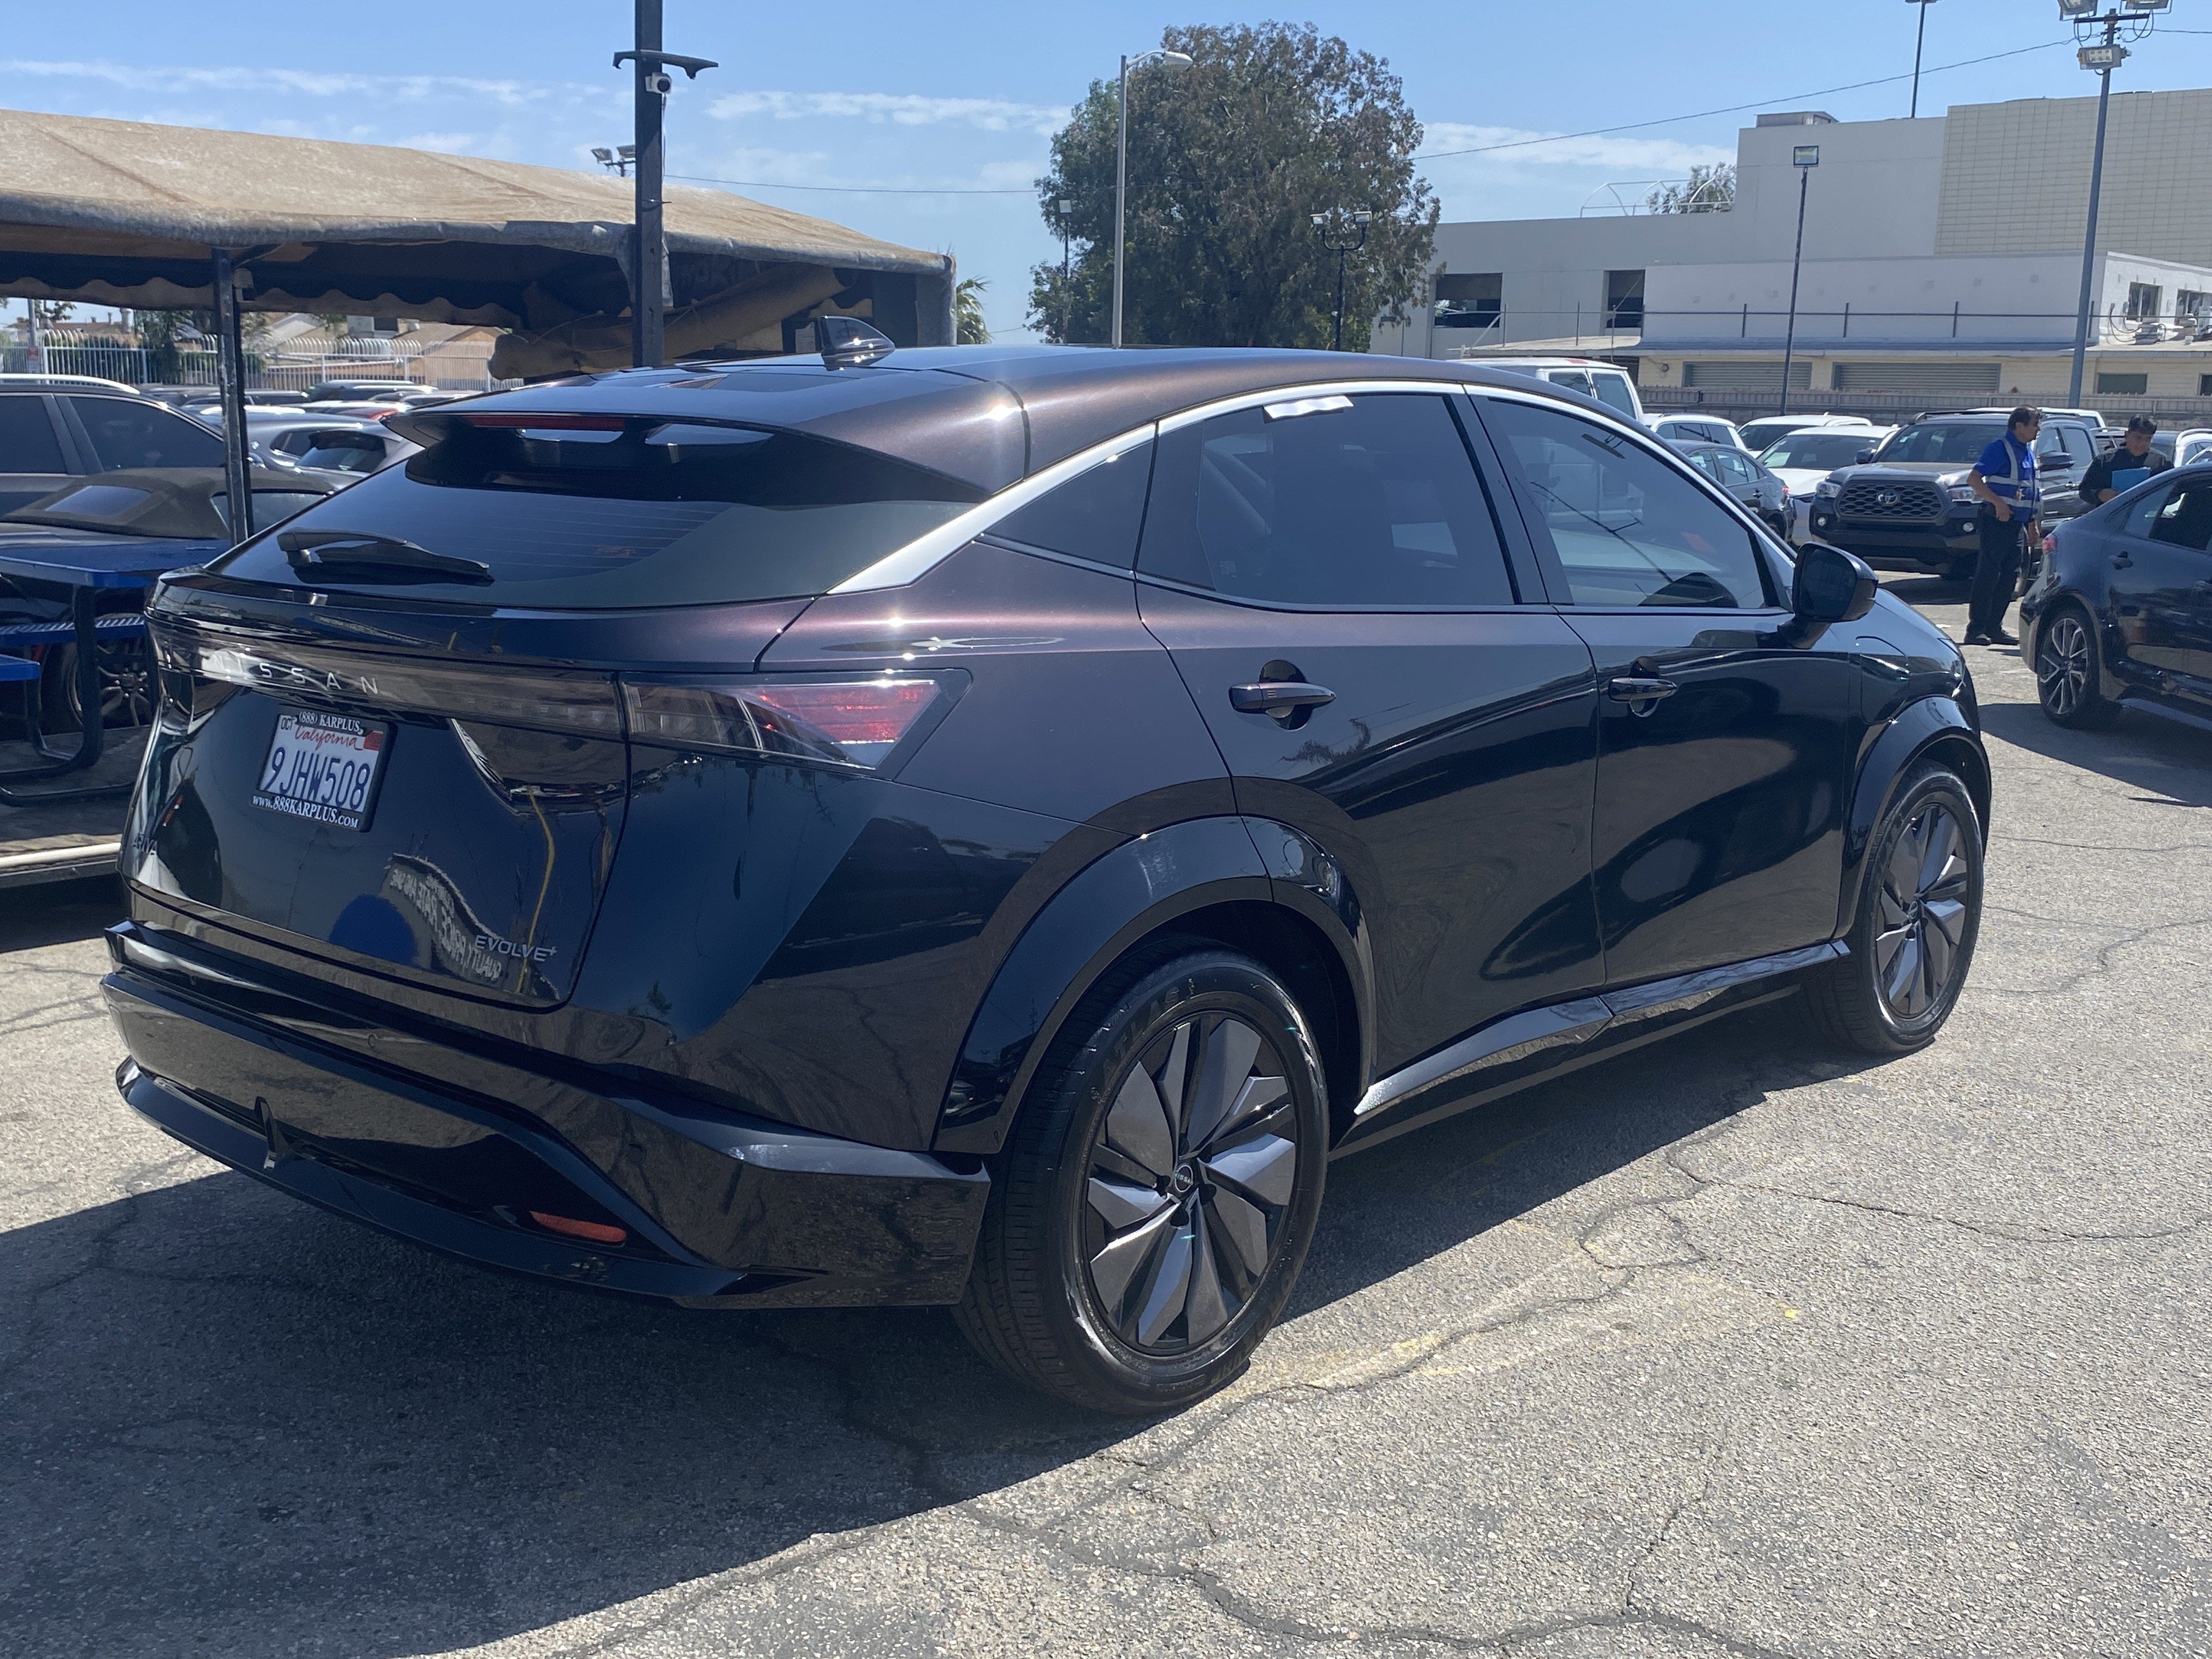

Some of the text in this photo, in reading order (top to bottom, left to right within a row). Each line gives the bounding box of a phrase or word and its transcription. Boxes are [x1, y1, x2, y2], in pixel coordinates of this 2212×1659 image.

[299, 711, 318, 725] (888)
[295, 725, 363, 751] California
[264, 747, 370, 810] 9JHW508
